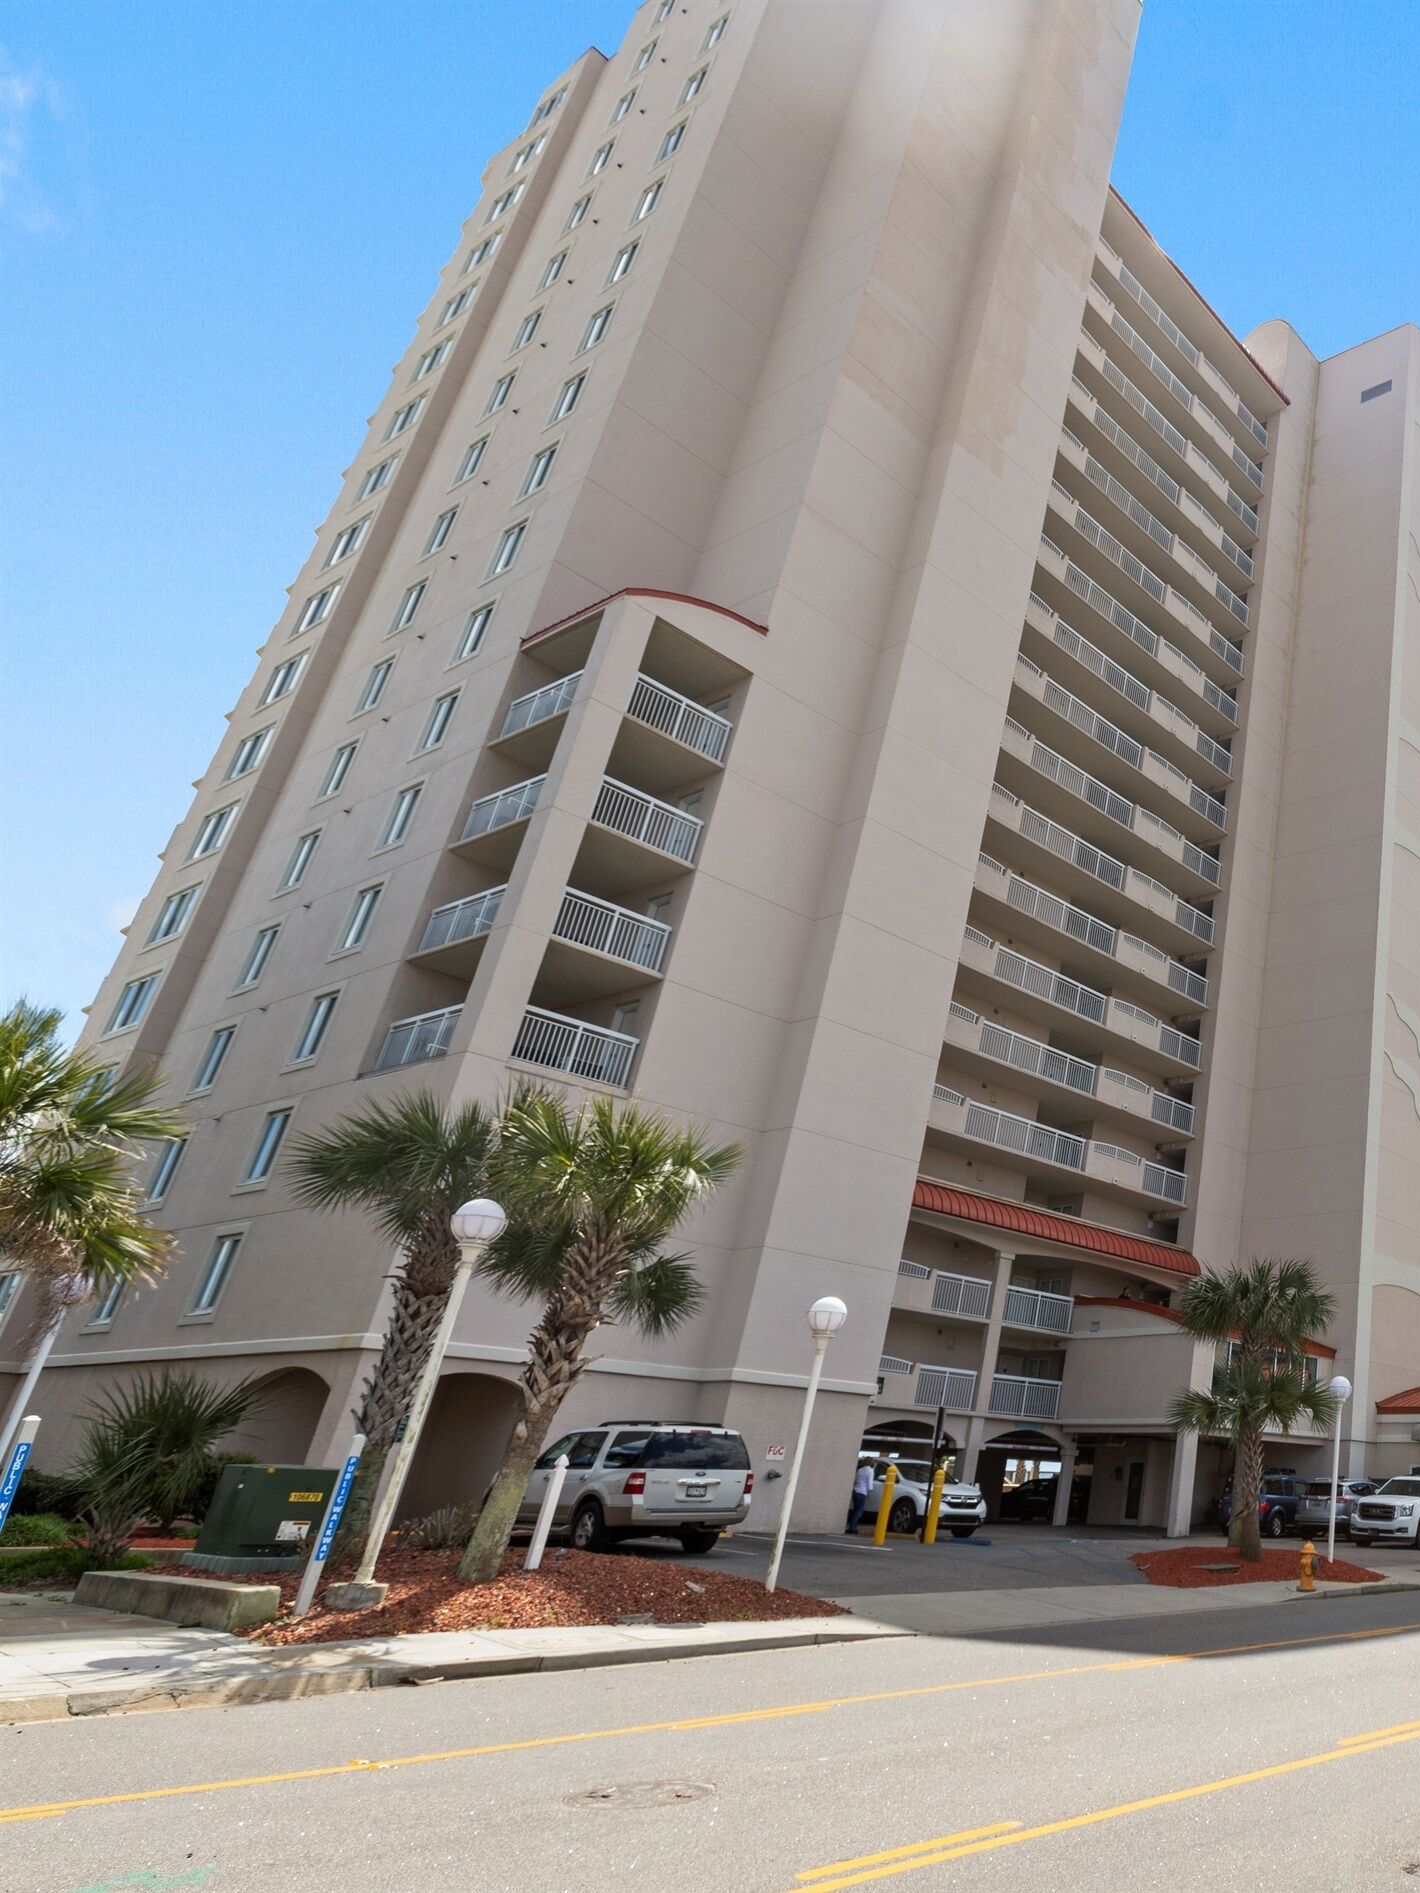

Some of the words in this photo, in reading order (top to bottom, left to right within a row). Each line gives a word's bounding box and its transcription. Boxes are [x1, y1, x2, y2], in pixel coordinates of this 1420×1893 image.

[4, 1445, 27, 1495] PUBLIC
[767, 1445, 784, 1456] FDC
[336, 1457, 357, 1503] PUBLIC
[318, 1506, 343, 1560] WALKWAY
